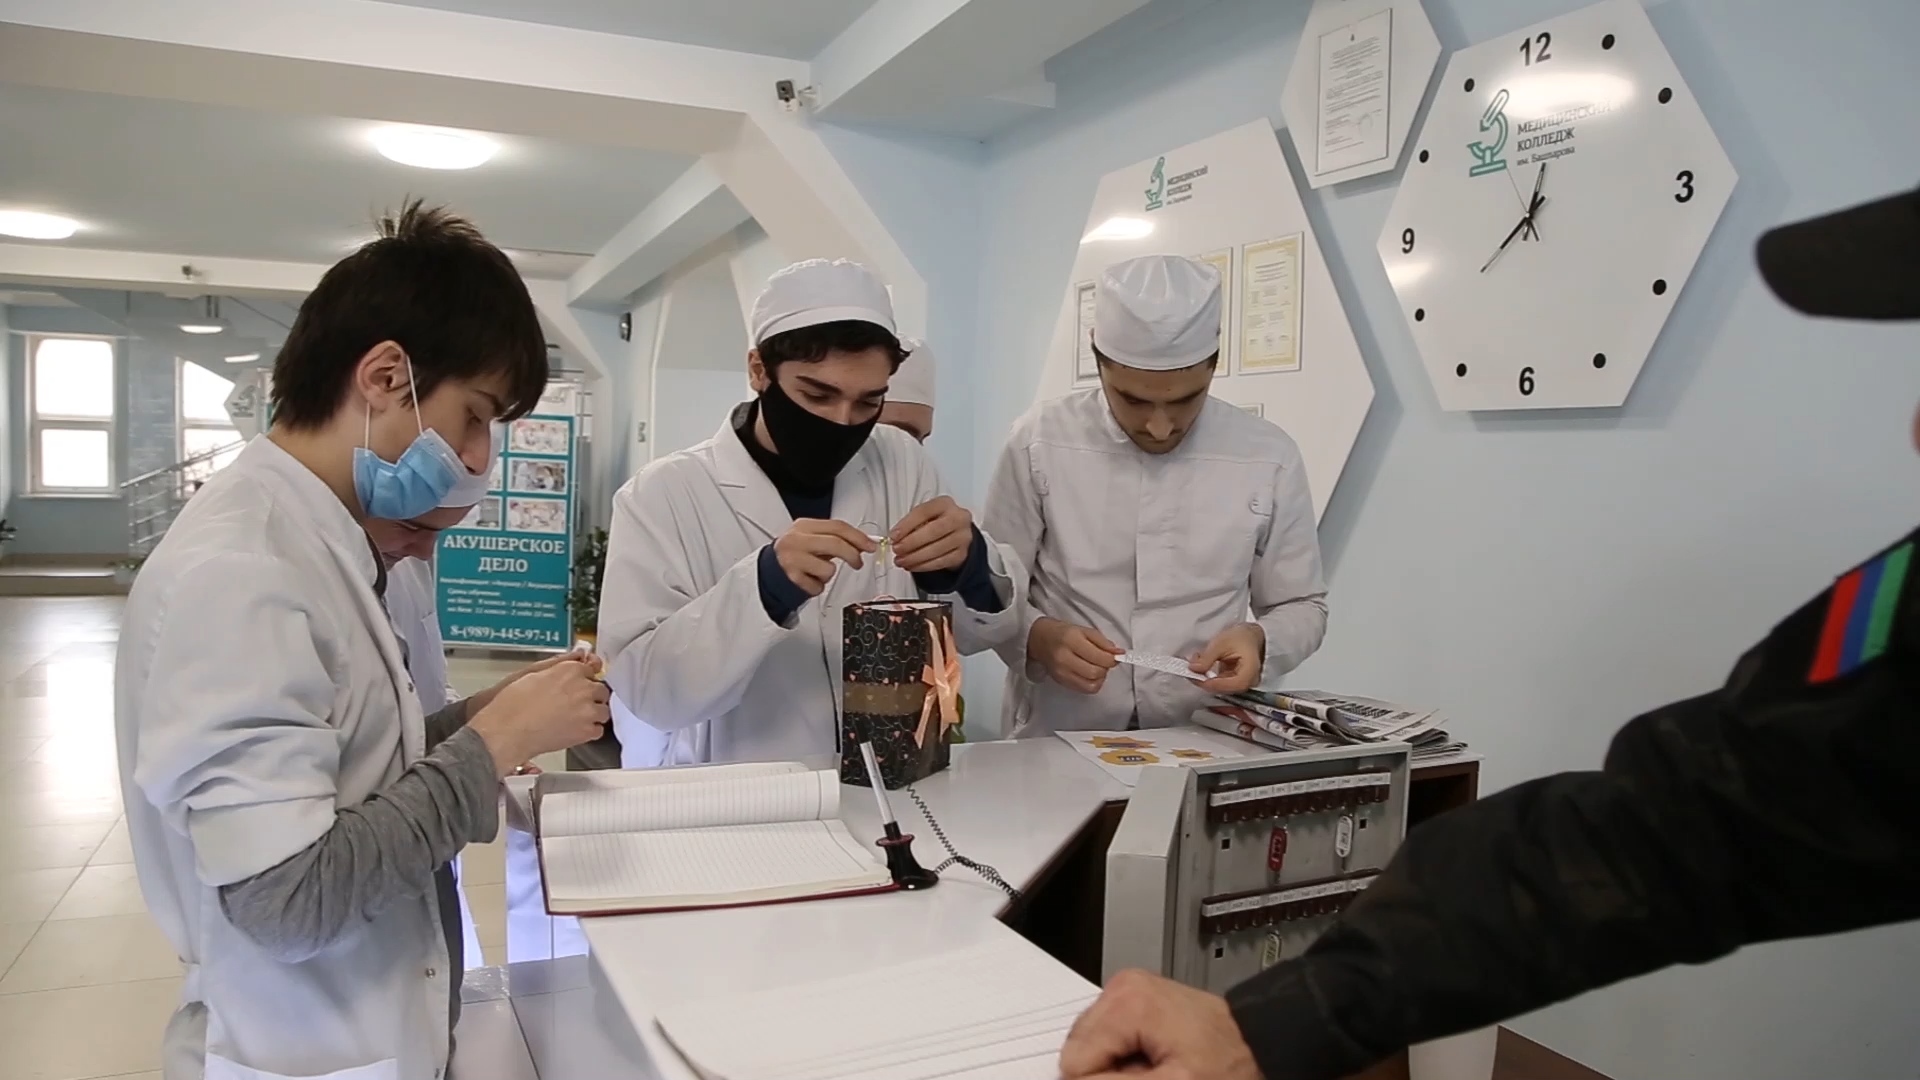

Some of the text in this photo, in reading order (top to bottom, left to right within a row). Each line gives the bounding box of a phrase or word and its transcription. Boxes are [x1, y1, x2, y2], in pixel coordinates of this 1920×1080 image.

[1519, 32, 1552, 67] 12
[1517, 127, 1575, 152] КОЛЛЕДЖ
[1674, 170, 1694, 203] 3
[1402, 228, 1415, 254] 9
[1519, 367, 1535, 396] 6
[443, 534, 565, 554] АКУШЕРСКОЕ
[478, 556, 529, 573] ДЕЛО
